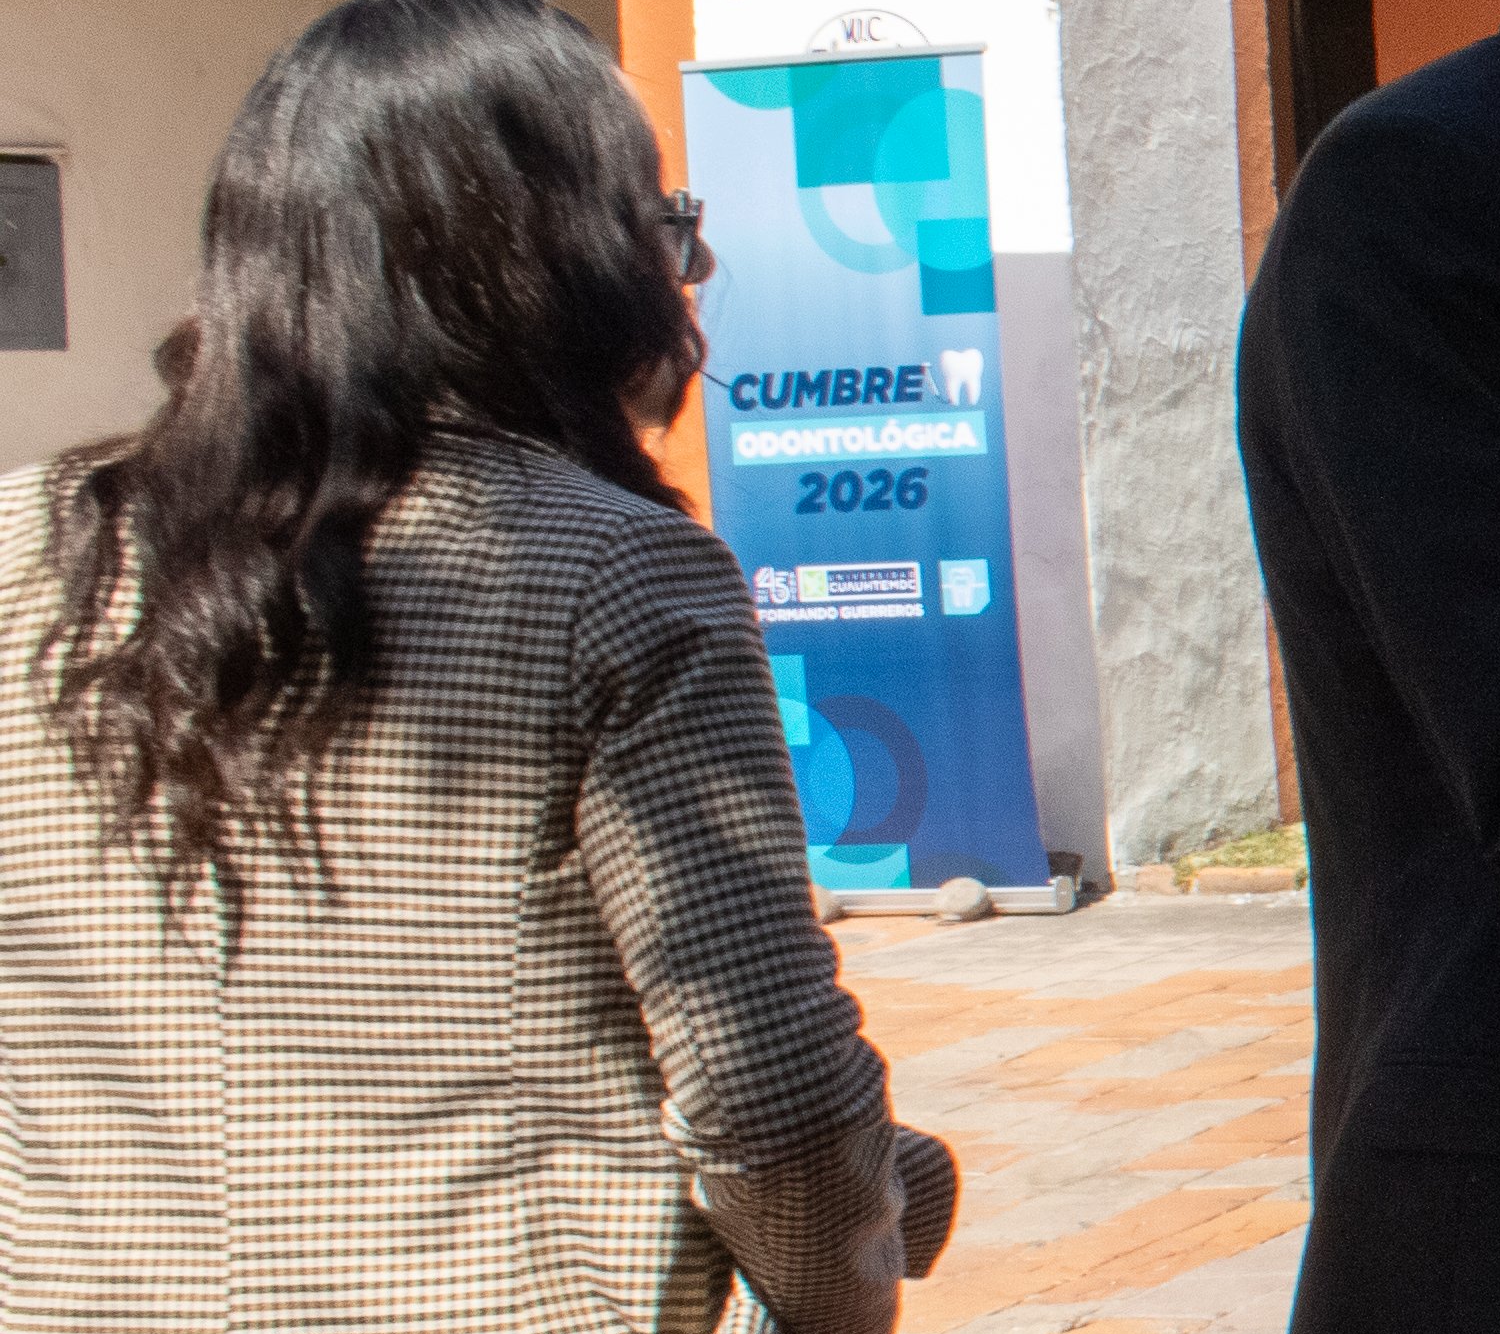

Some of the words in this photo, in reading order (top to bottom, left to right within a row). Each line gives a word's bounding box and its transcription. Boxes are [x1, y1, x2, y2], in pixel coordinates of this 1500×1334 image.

[730, 364, 926, 411] CUMBRE
[736, 418, 978, 459] ODONTOLÓGICA
[795, 466, 929, 515] 2026
[757, 606, 838, 623] FORMANDO
[839, 602, 925, 619] GUERREROS
